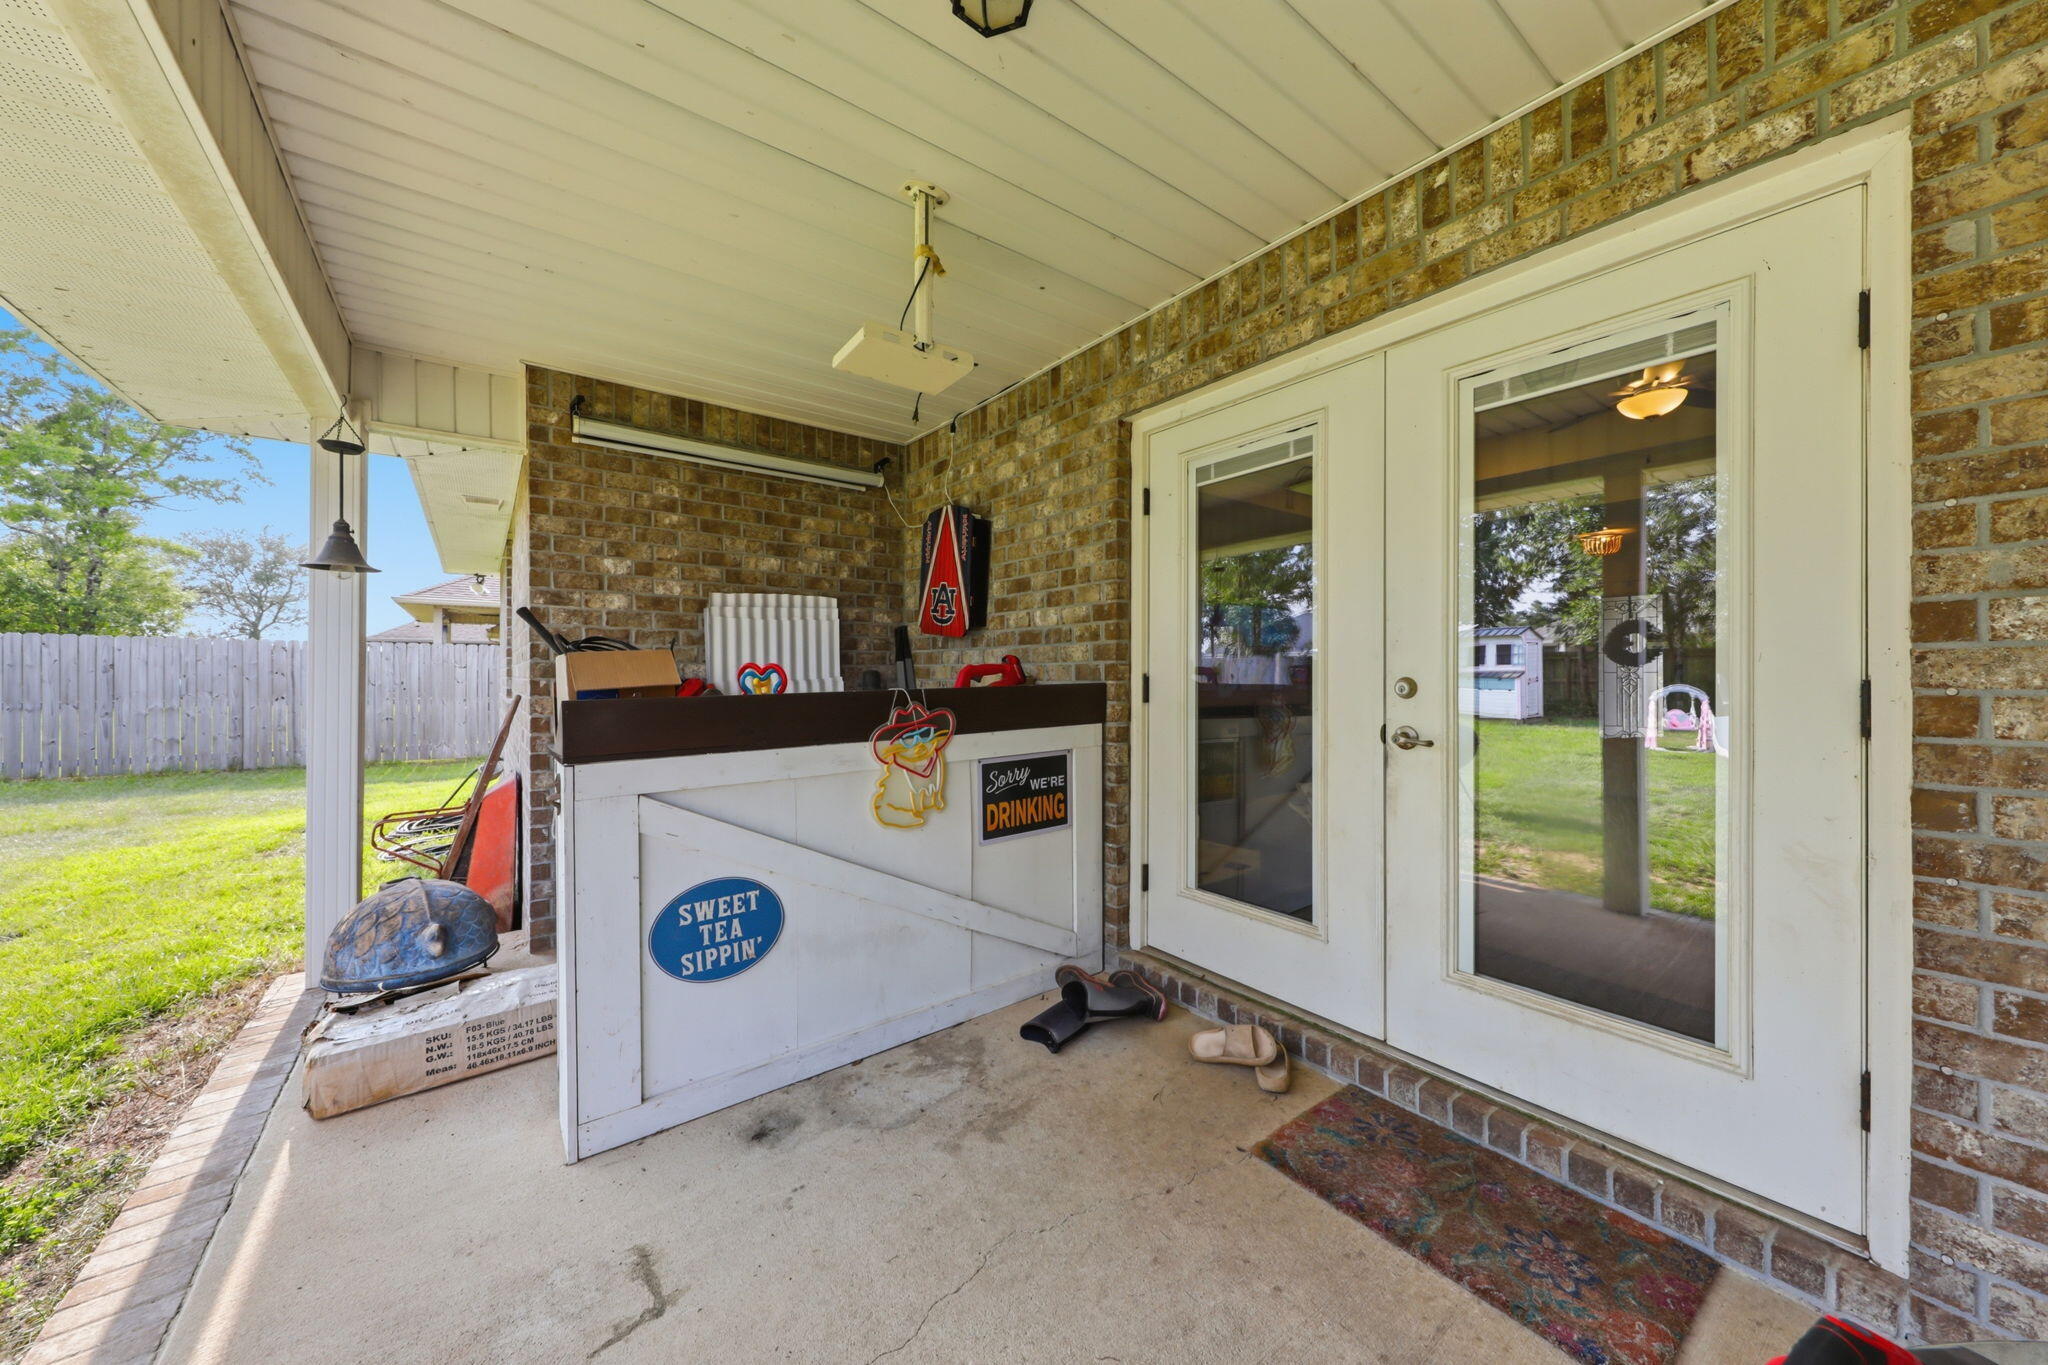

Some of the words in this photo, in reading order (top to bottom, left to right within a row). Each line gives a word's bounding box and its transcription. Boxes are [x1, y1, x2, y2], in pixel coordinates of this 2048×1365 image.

[986, 766, 1031, 794] Sorry
[1030, 775, 1065, 790] WE'RE
[987, 792, 1065, 831] DRINKING
[678, 890, 760, 927] SWEET
[699, 918, 743, 946] TEA
[680, 936, 762, 976] SIPPIN'
[426, 1033, 451, 1044] SKU:
[466, 1019, 505, 1034] F03-Blue
[486, 1027, 506, 1038] KGS
[536, 1014, 553, 1024] LBS
[486, 1036, 506, 1046] KGS
[536, 1023, 554, 1032] LBS
[426, 1064, 457, 1076] Meas:
[521, 1037, 534, 1046] CM
[535, 1039, 556, 1050] INCH
